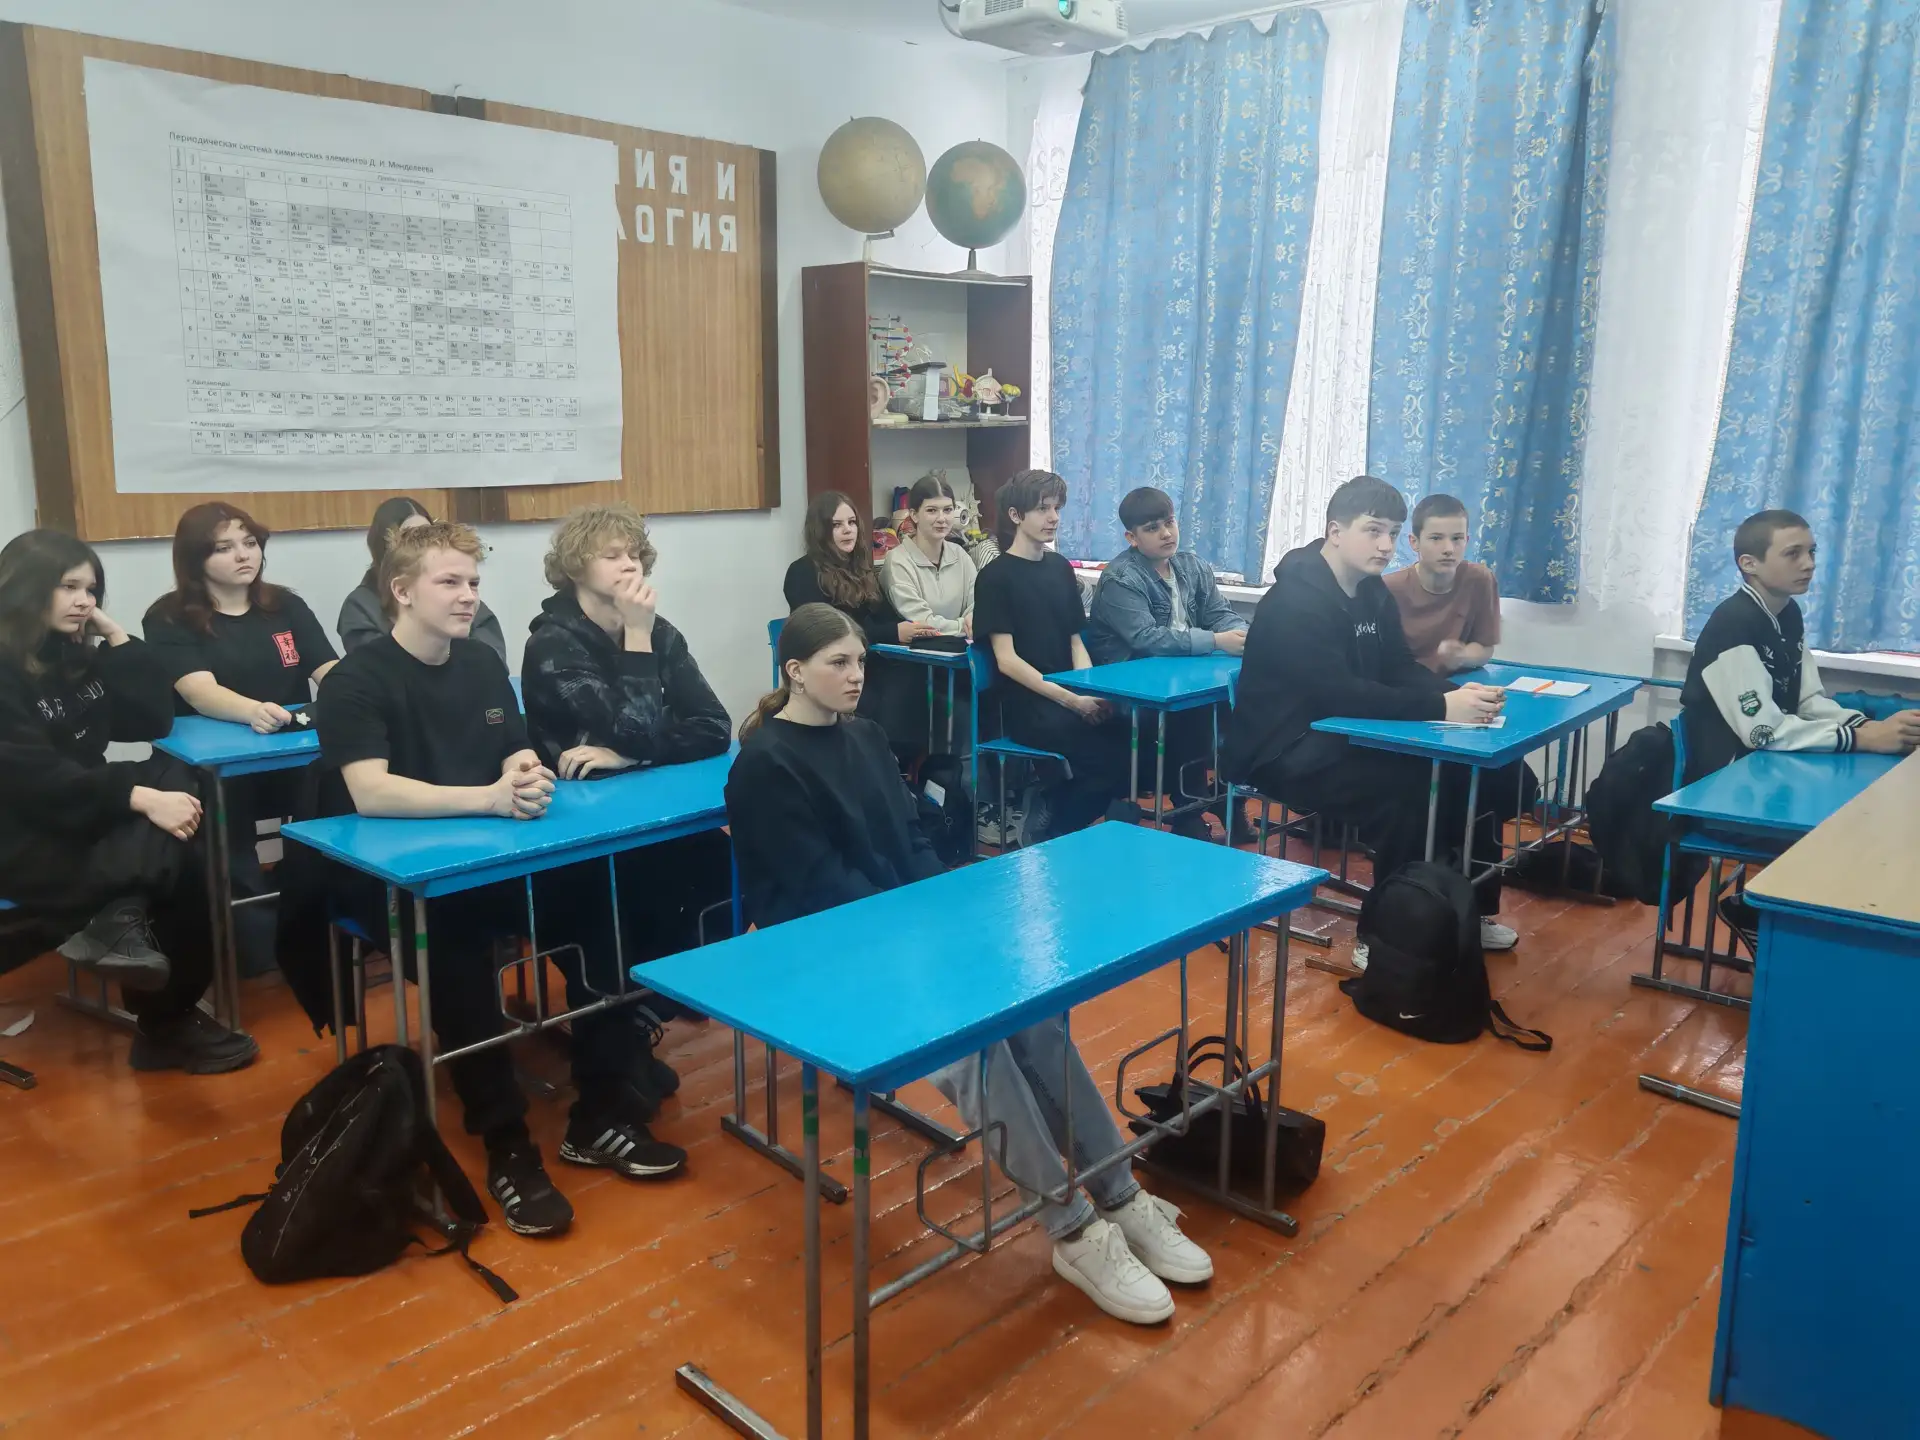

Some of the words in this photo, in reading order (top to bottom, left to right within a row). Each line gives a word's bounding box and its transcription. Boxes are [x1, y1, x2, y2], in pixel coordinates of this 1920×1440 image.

[169, 131, 238, 149] Периодическая
[239, 143, 273, 155] система
[273, 148, 324, 161] химических
[325, 154, 368, 166] элементов
[614, 144, 688, 195] ИЯ
[717, 161, 736, 202] И
